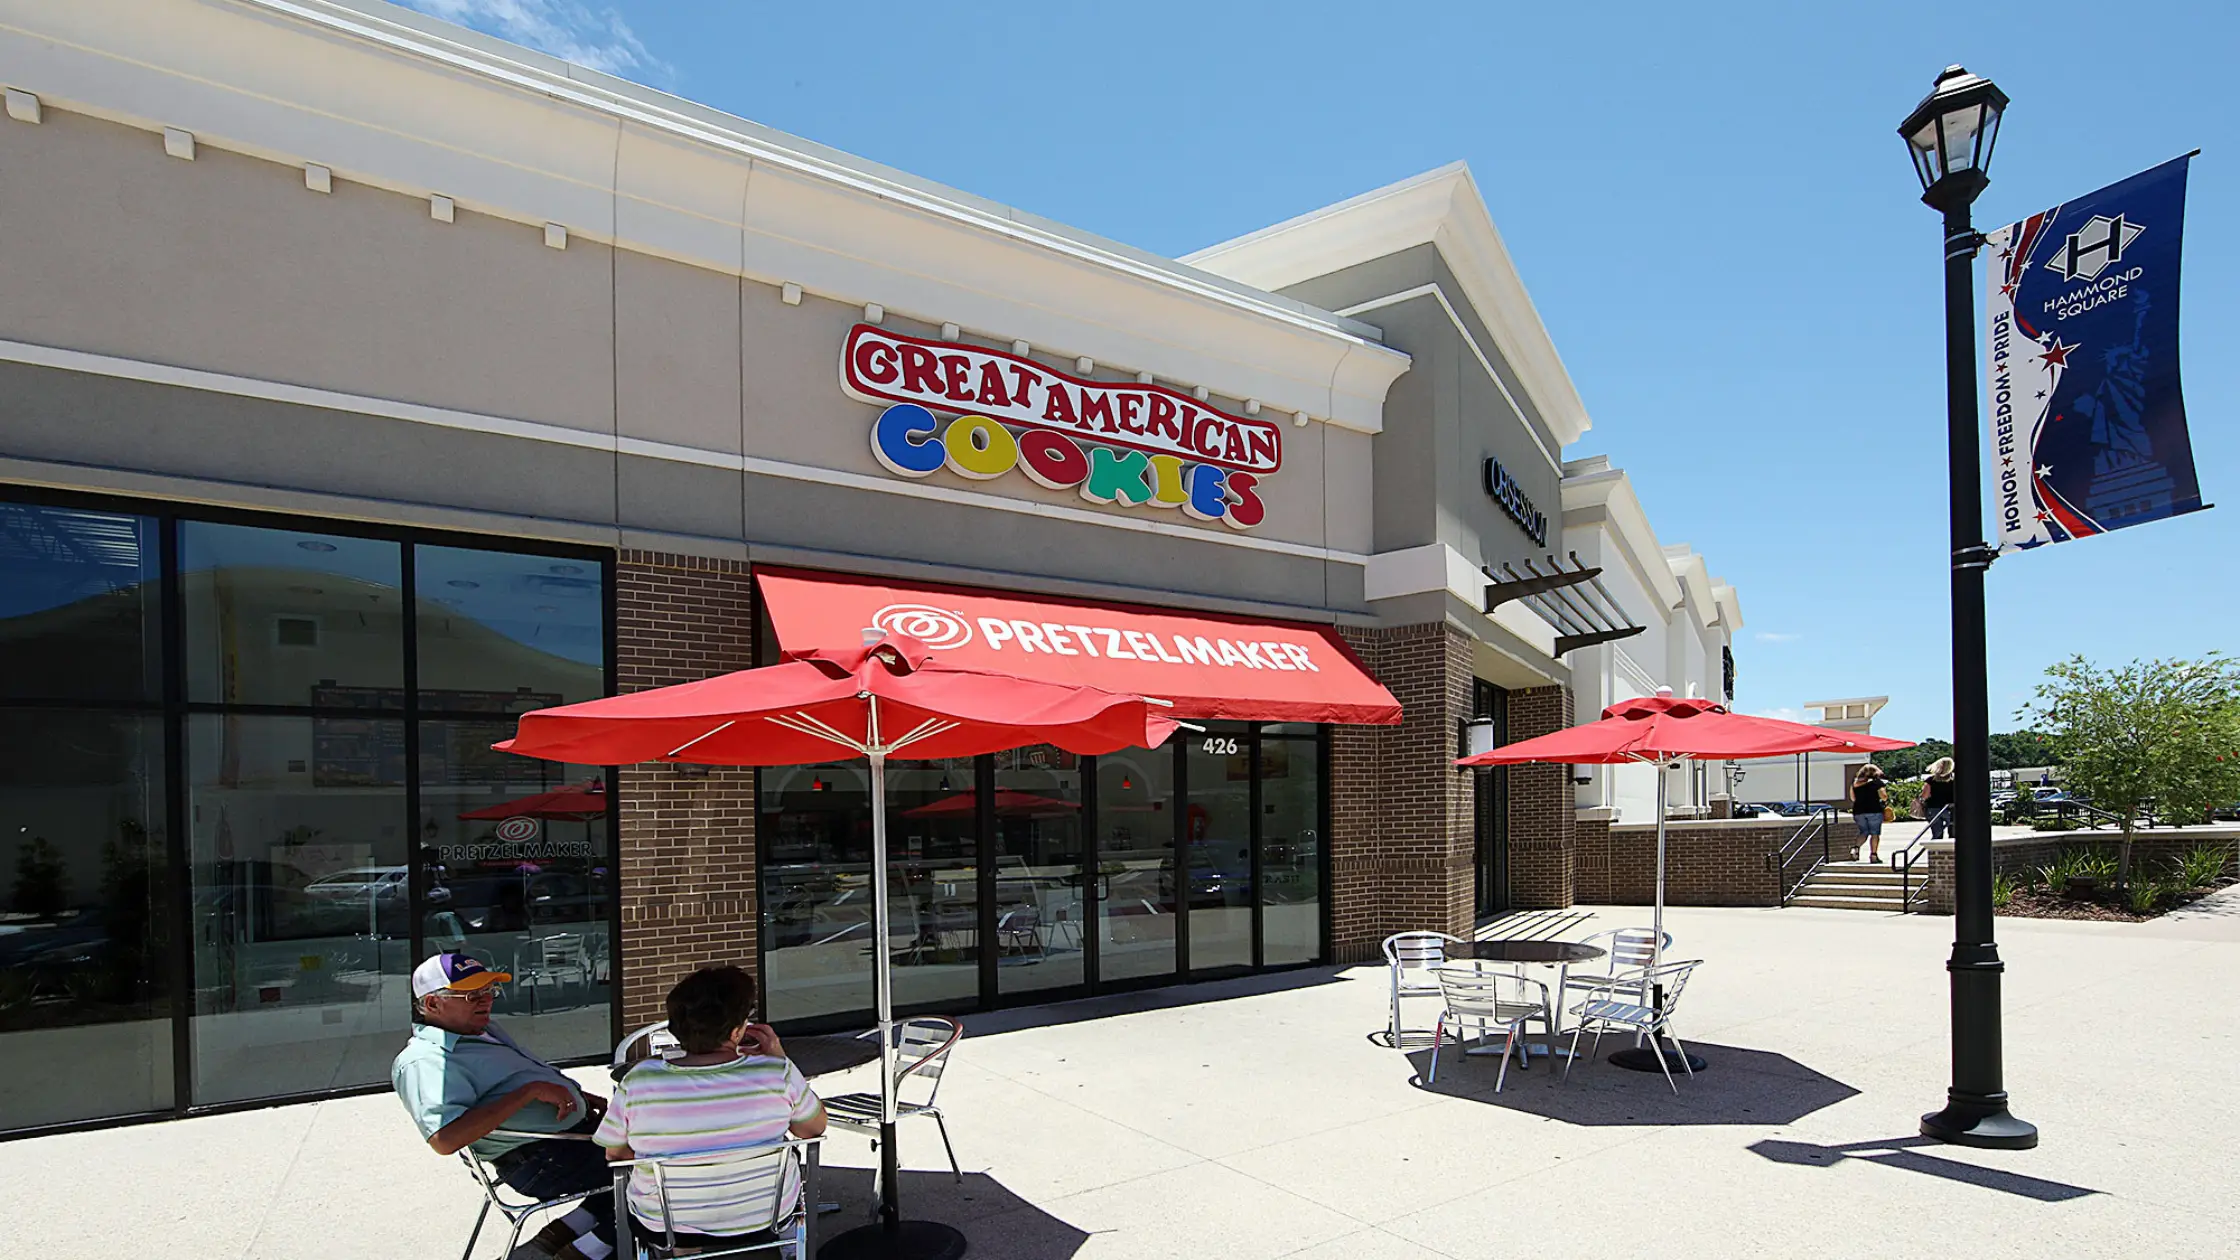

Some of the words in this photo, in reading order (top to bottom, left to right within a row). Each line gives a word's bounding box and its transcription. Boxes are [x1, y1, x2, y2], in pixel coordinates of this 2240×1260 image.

[2044, 266, 2144, 313] HAMMOND
[2057, 285, 2128, 321] SQUARE
[1994, 310, 2010, 362] PRIDE
[855, 340, 1042, 409] GREAT
[1041, 382, 1277, 466] AMERICAN
[1995, 372, 2015, 458] FREEDOM
[871, 402, 1266, 530] COOKIES
[1483, 456, 1547, 548] OBSESSON
[2001, 468, 2021, 533] HONOR
[976, 617, 1320, 672] PRETZELMAKER
[1203, 738, 1238, 755] 426
[438, 841, 593, 861] PRETZELMAKER
